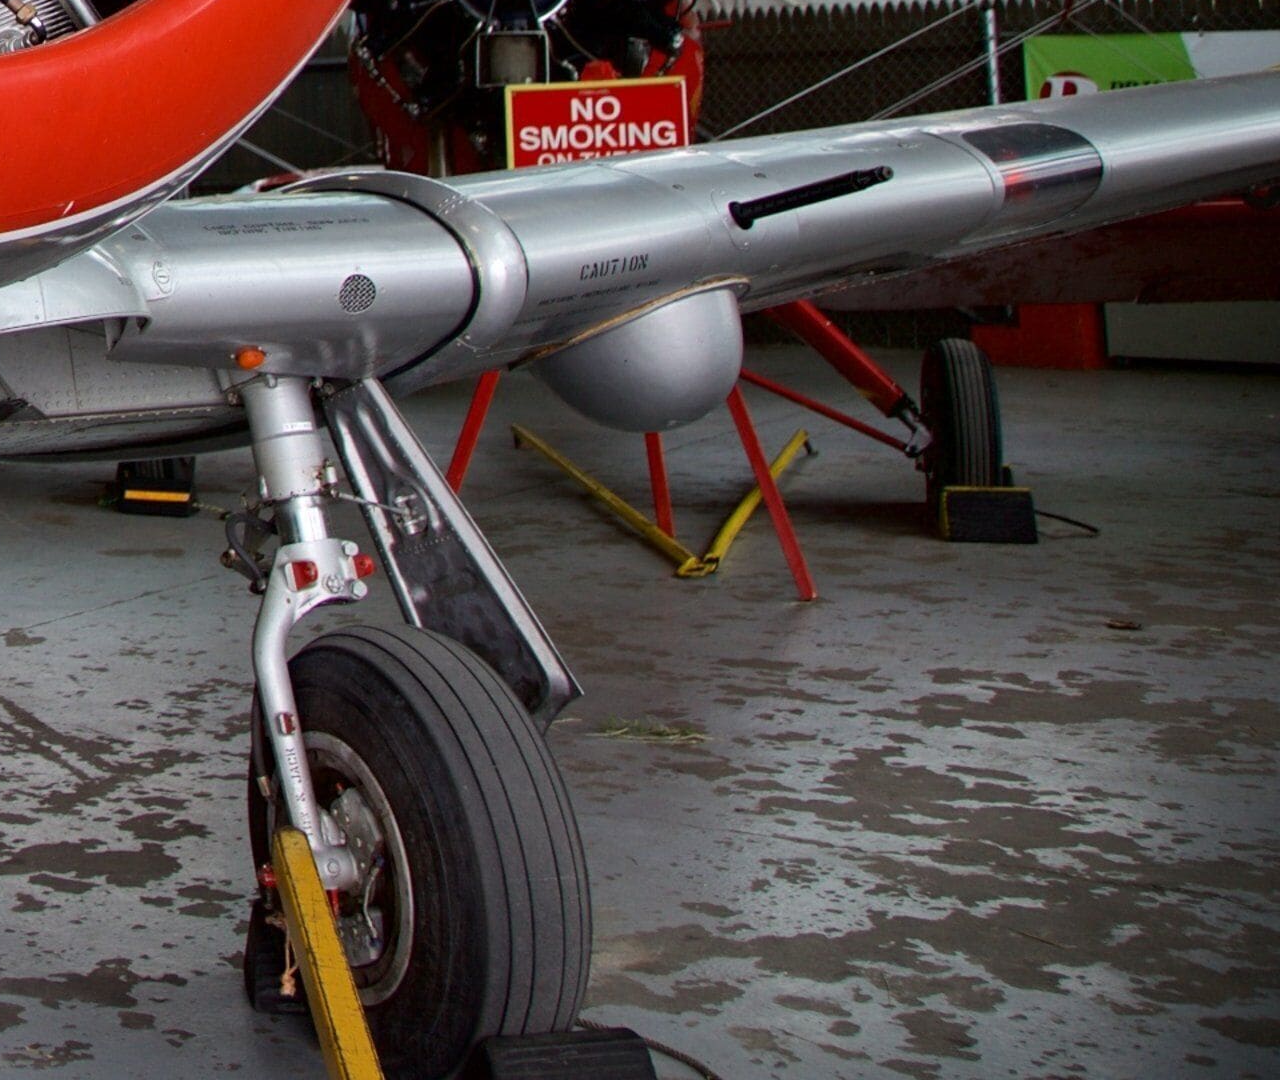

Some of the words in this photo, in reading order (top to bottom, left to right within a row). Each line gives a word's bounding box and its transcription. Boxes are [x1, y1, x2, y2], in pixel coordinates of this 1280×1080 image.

[569, 95, 622, 123] NO
[518, 119, 678, 152] SMOKING
[579, 253, 649, 281] CAUTION
